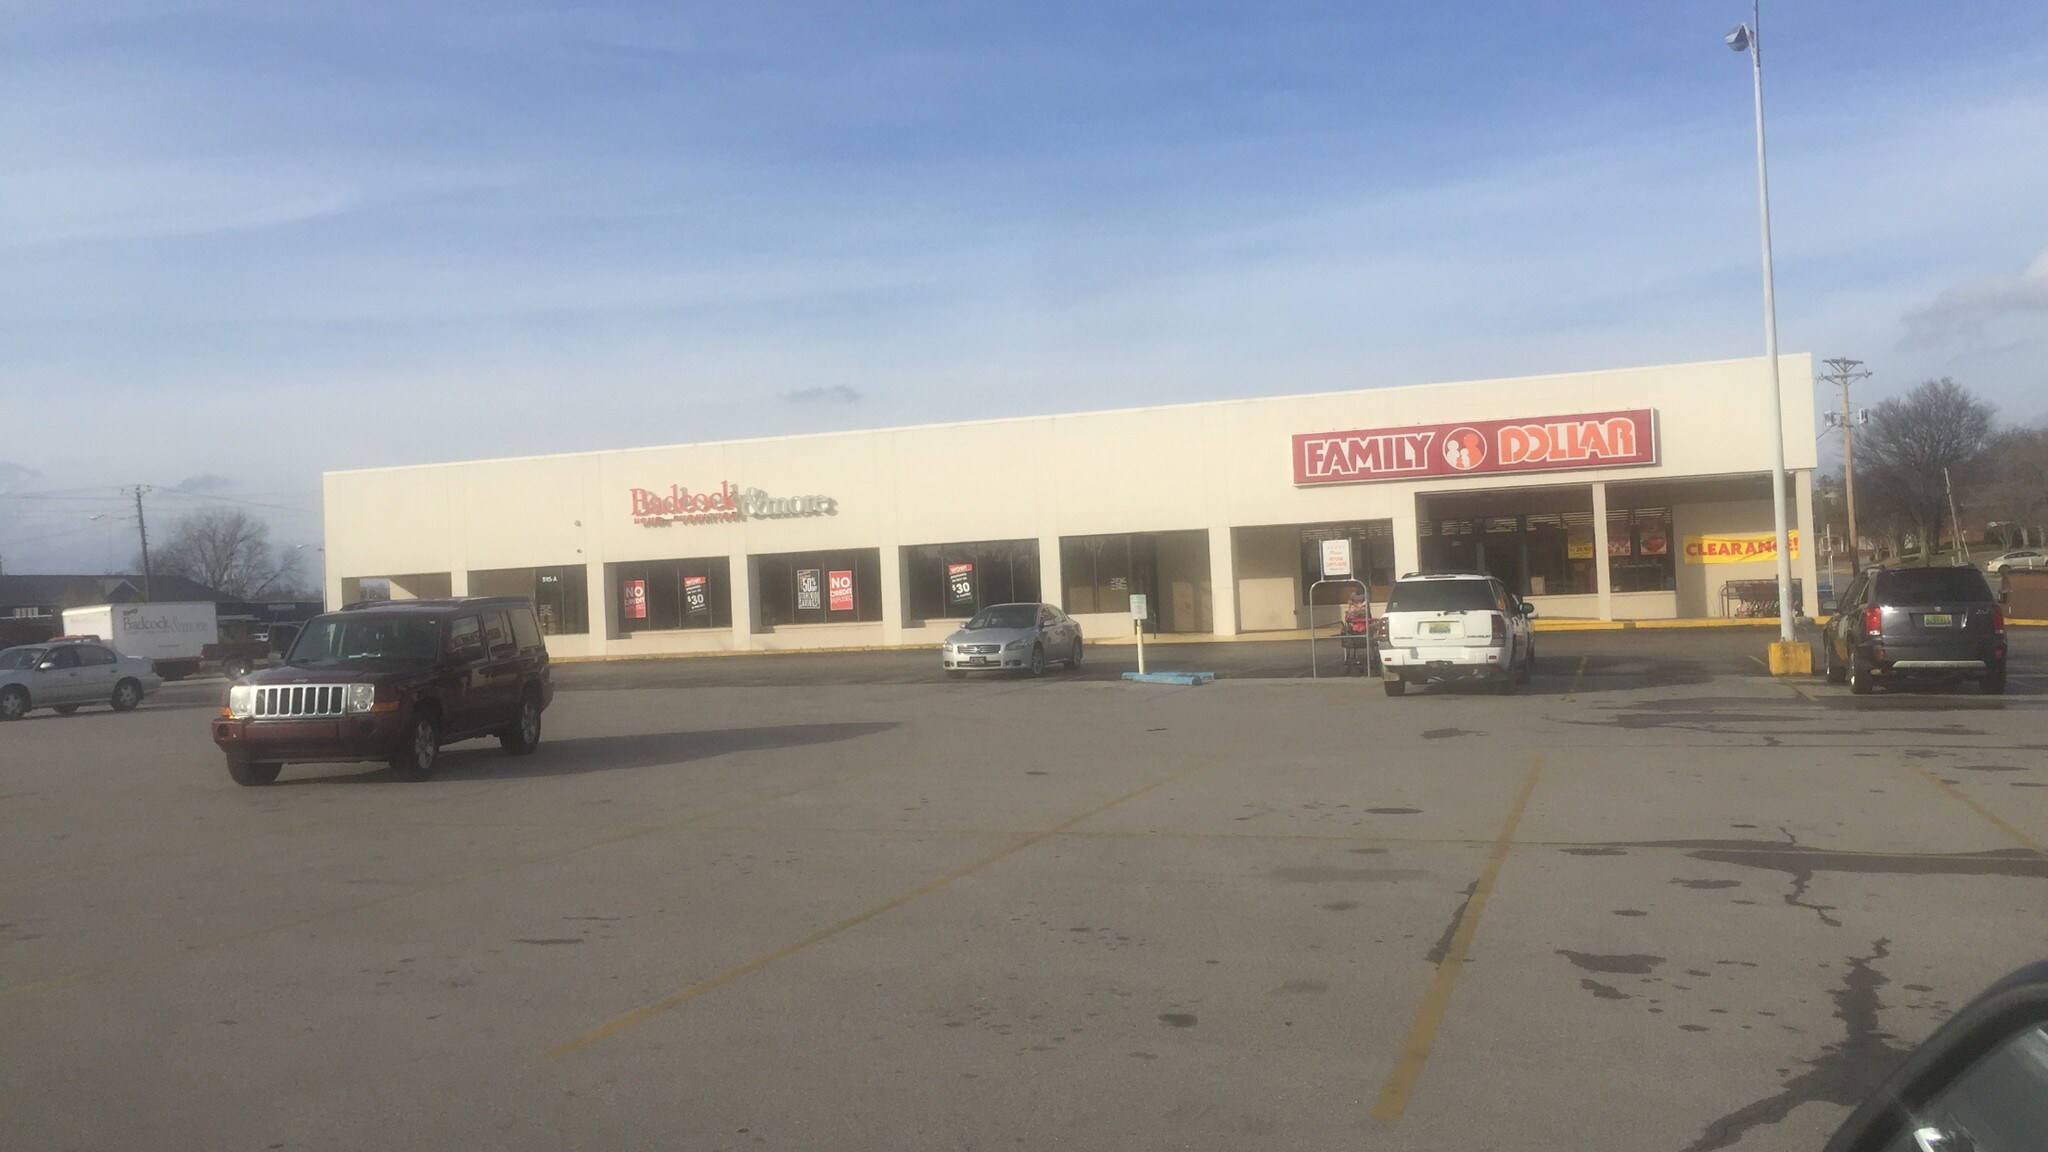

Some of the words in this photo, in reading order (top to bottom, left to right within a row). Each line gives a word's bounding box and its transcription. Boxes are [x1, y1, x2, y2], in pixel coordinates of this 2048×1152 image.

[1303, 431, 1436, 477] FAMILY
[1497, 417, 1638, 465] DOLLAR
[629, 480, 738, 516] Badcock
[1685, 537, 1799, 556] CLEARAN!
[831, 577, 850, 588] NO
[952, 582, 970, 594] $30
[625, 586, 643, 597] NO
[687, 594, 704, 605] $30
[123, 615, 169, 630] Badcock
